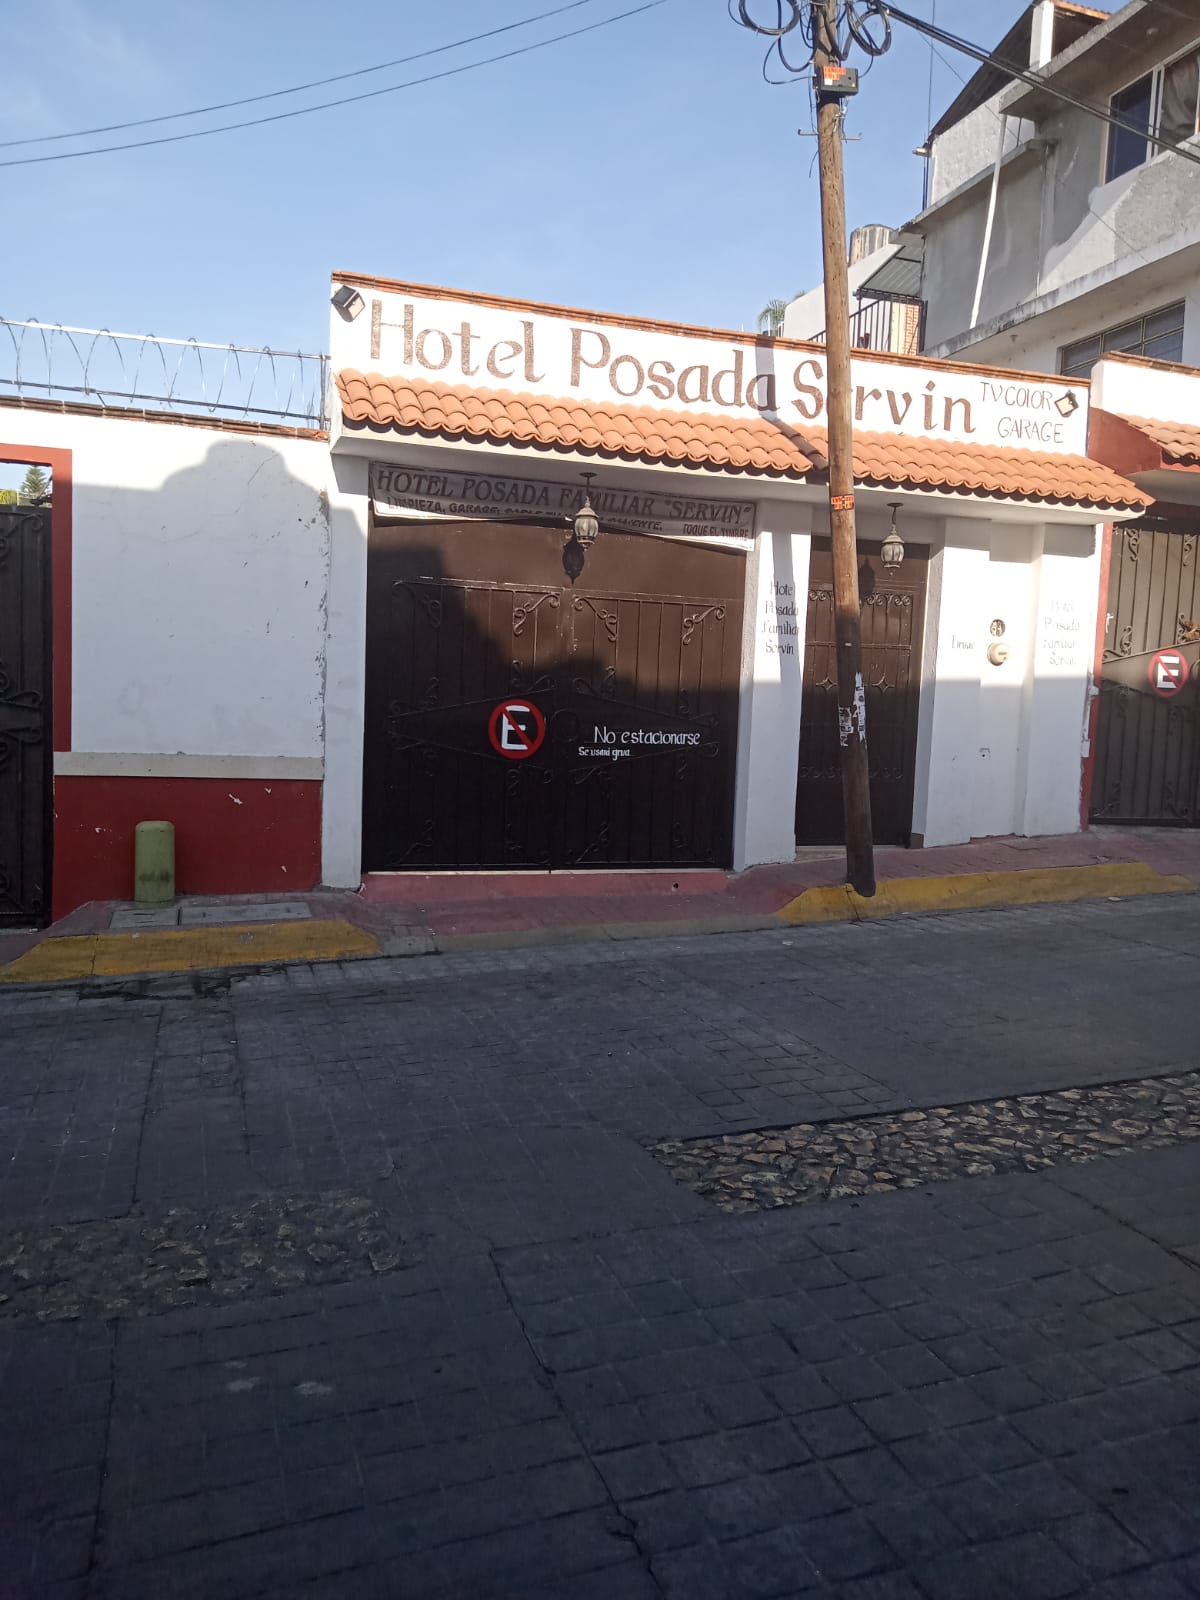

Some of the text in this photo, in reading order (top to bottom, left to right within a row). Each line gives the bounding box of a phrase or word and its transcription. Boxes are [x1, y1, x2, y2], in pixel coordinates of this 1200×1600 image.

[370, 299, 976, 433] Hotel Posada Srvin
[997, 416, 1064, 444] GARAGE
[377, 470, 454, 497] HOTEL
[461, 478, 551, 506] POSADA
[558, 488, 656, 514] FAMILIAR
[593, 725, 701, 746] No estacionarse
